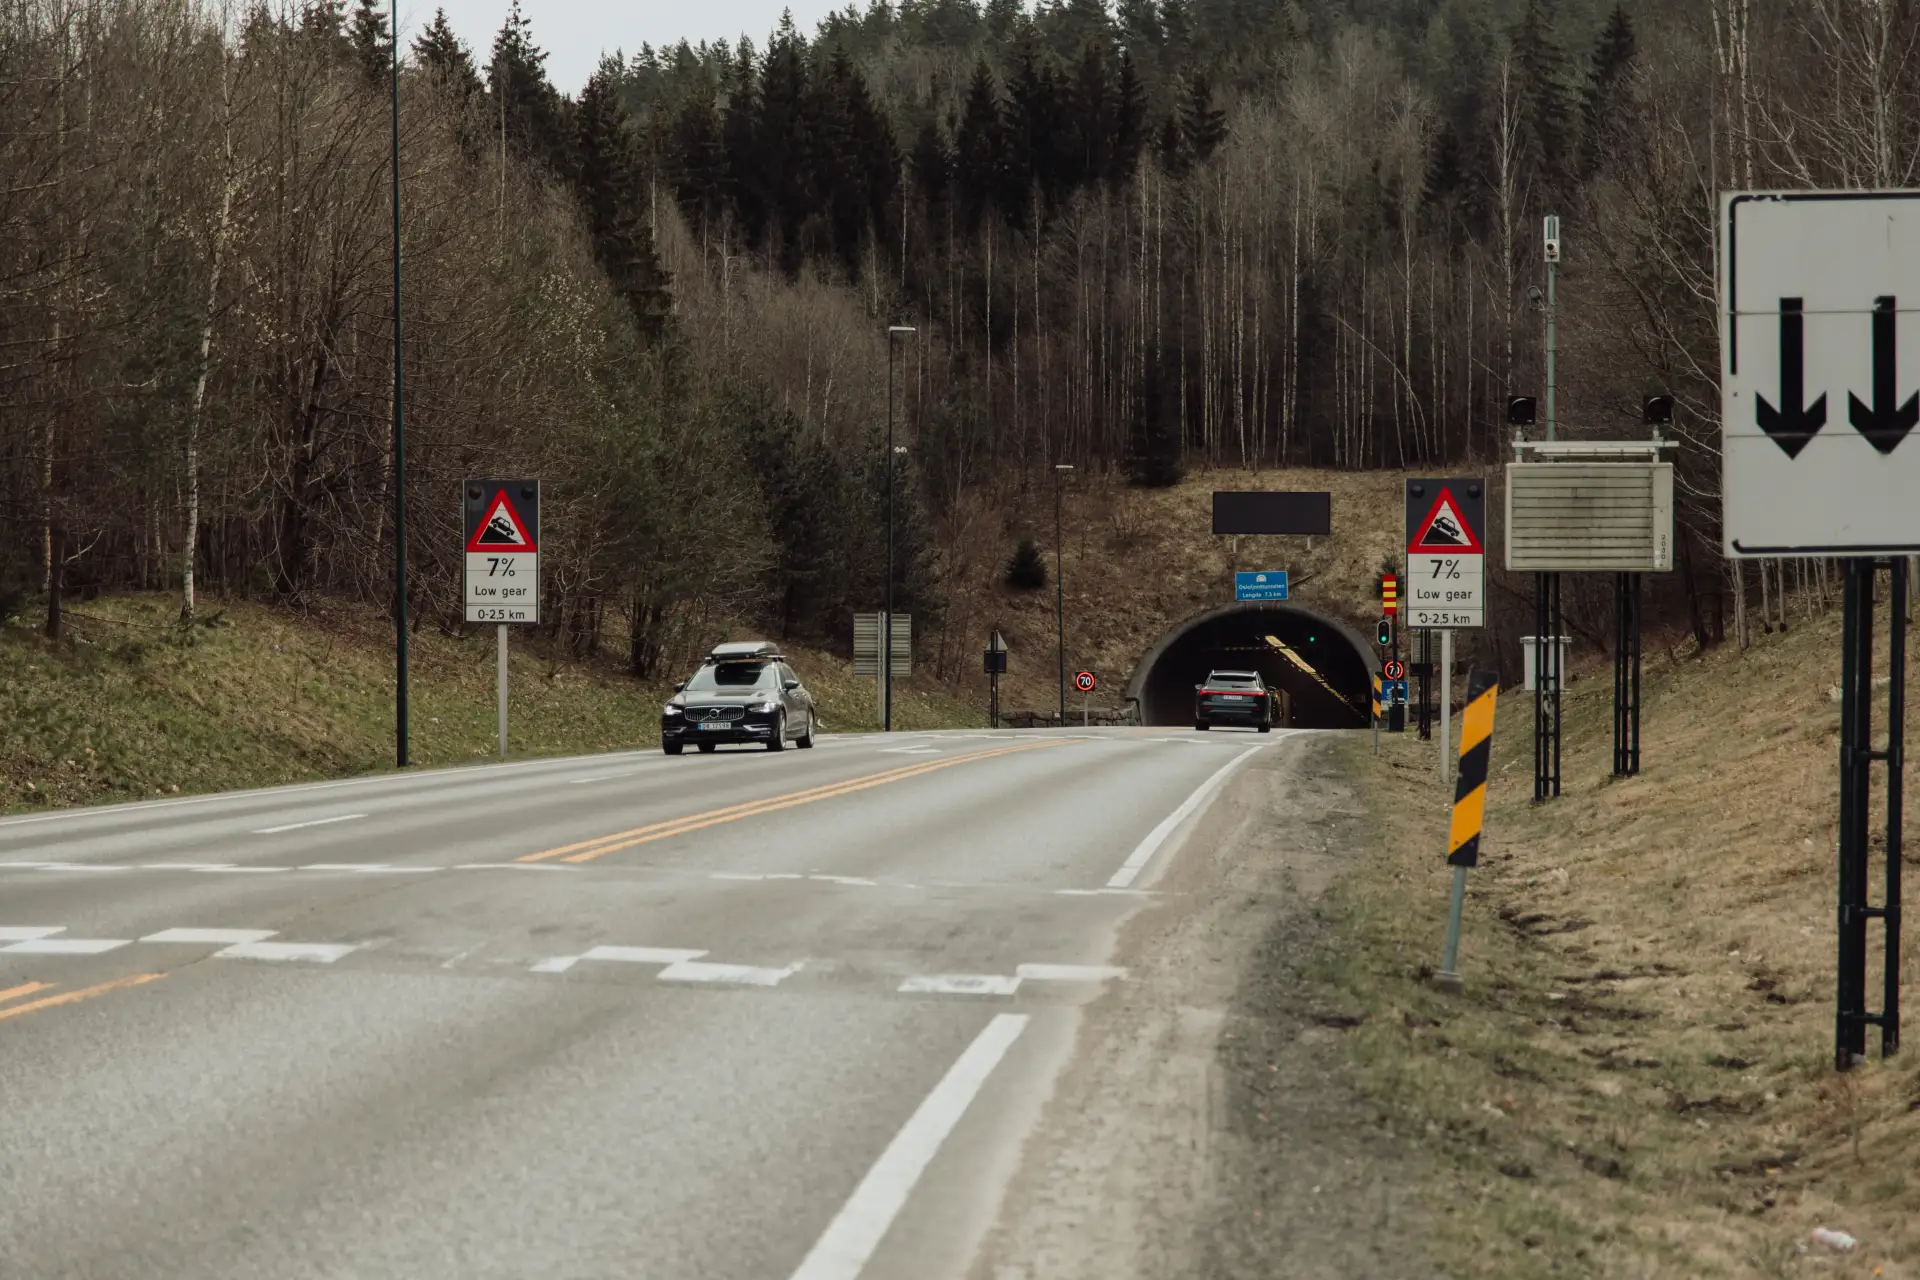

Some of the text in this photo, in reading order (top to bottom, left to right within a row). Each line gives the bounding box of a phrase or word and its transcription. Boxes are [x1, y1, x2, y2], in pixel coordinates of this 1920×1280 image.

[487, 558, 515, 577] 7%
[1430, 560, 1460, 579] 7%
[475, 586, 527, 598] Low gear
[1417, 589, 1472, 602] Low gear
[478, 609, 525, 620] 0-2,5 km
[1453, 613, 1471, 624] km
[1080, 676, 1091, 685] 70
